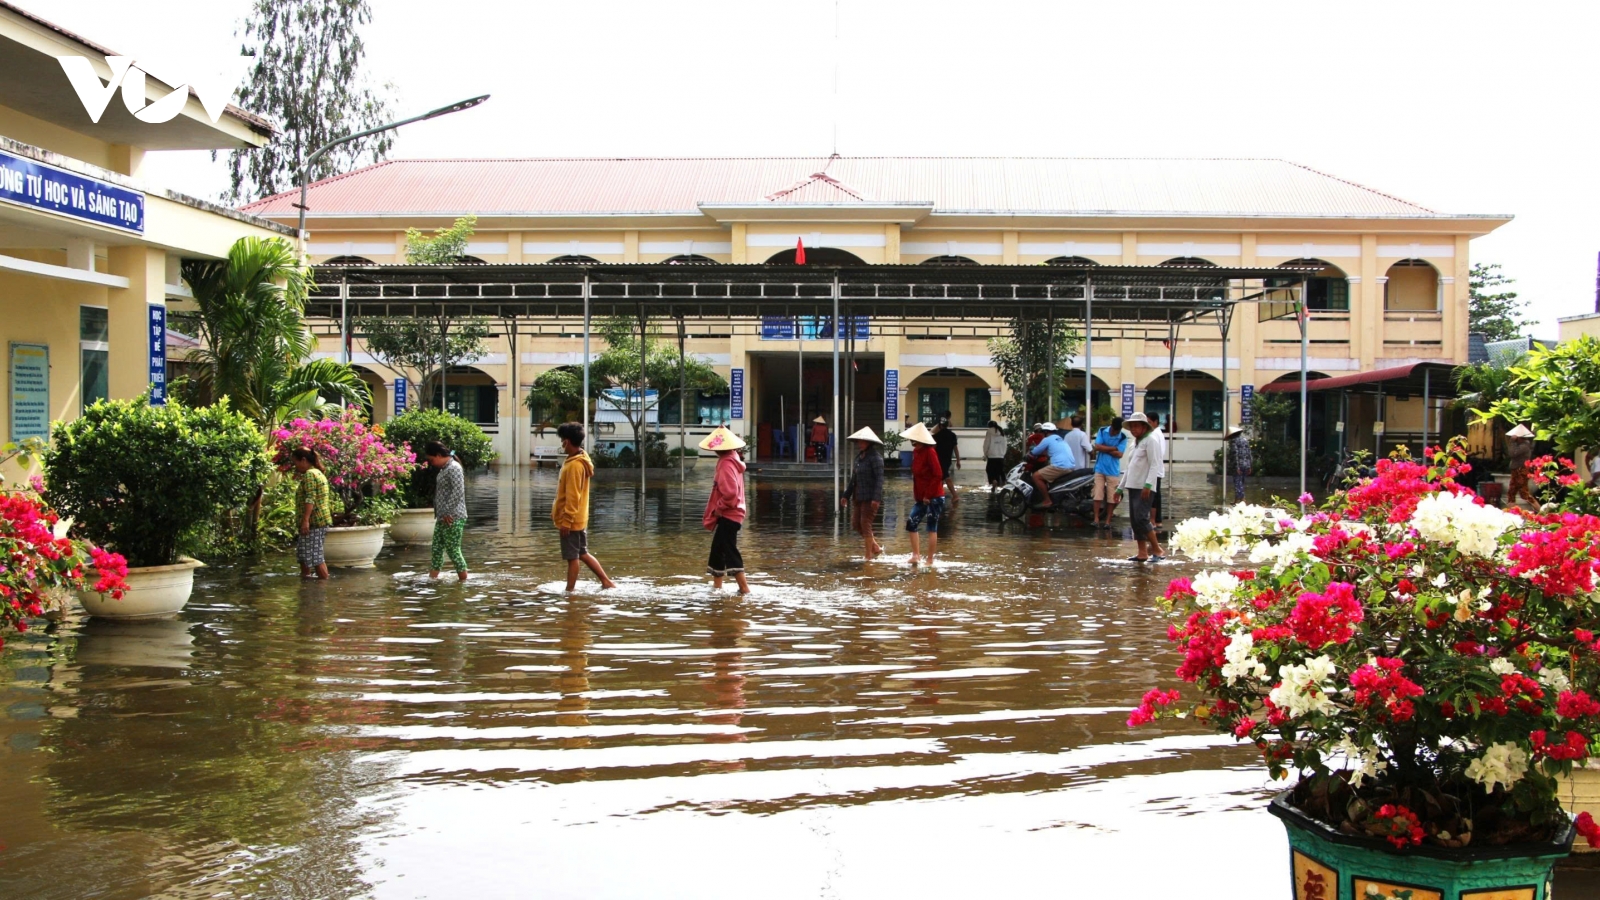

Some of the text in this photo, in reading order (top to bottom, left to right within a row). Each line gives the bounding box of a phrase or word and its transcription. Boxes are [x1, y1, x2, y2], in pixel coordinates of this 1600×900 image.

[26, 174, 43, 204] TỰ
[44, 179, 69, 208] HỌC
[71, 184, 87, 211] VÀ
[88, 189, 117, 218] SÁNG
[118, 199, 138, 226] TẠO
[152, 310, 162, 322] HỌC
[152, 324, 162, 338] TẬP
[152, 356, 164, 367] PHÁT
